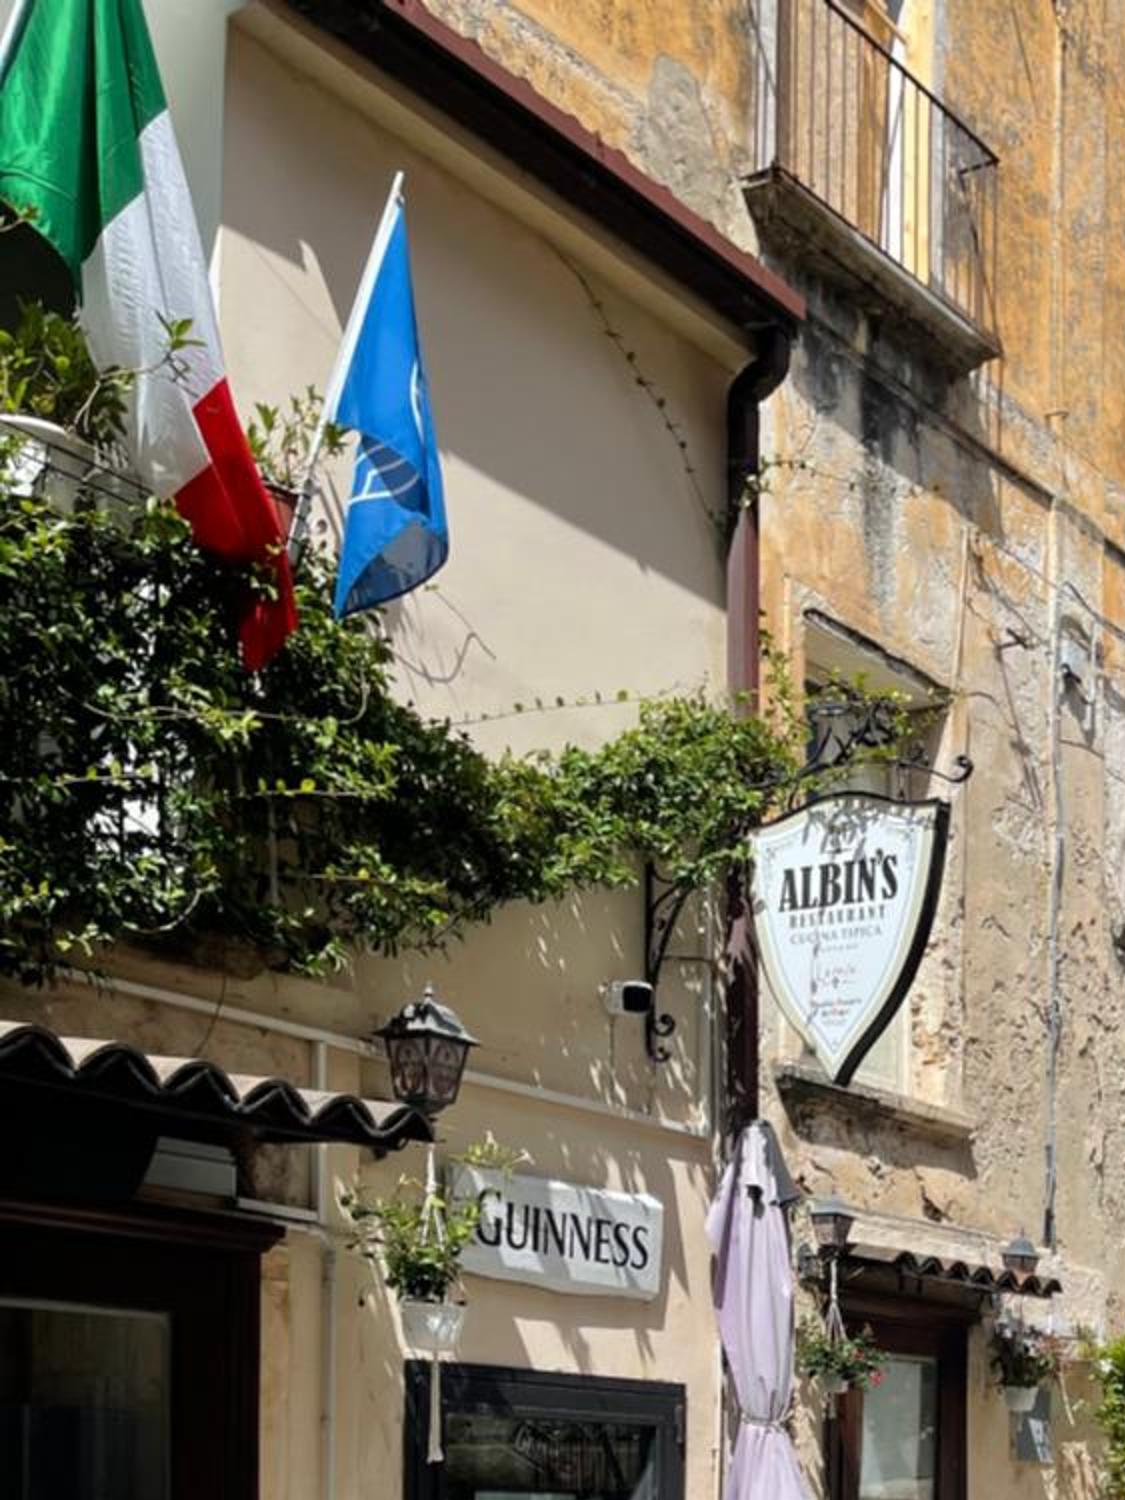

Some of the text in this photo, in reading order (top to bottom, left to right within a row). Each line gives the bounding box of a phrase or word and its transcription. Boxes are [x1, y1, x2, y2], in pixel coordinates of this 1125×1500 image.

[778, 848, 898, 912] ALBIN'S
[789, 904, 885, 929] RESTAURANT
[476, 1187, 650, 1270] GUINNESS
